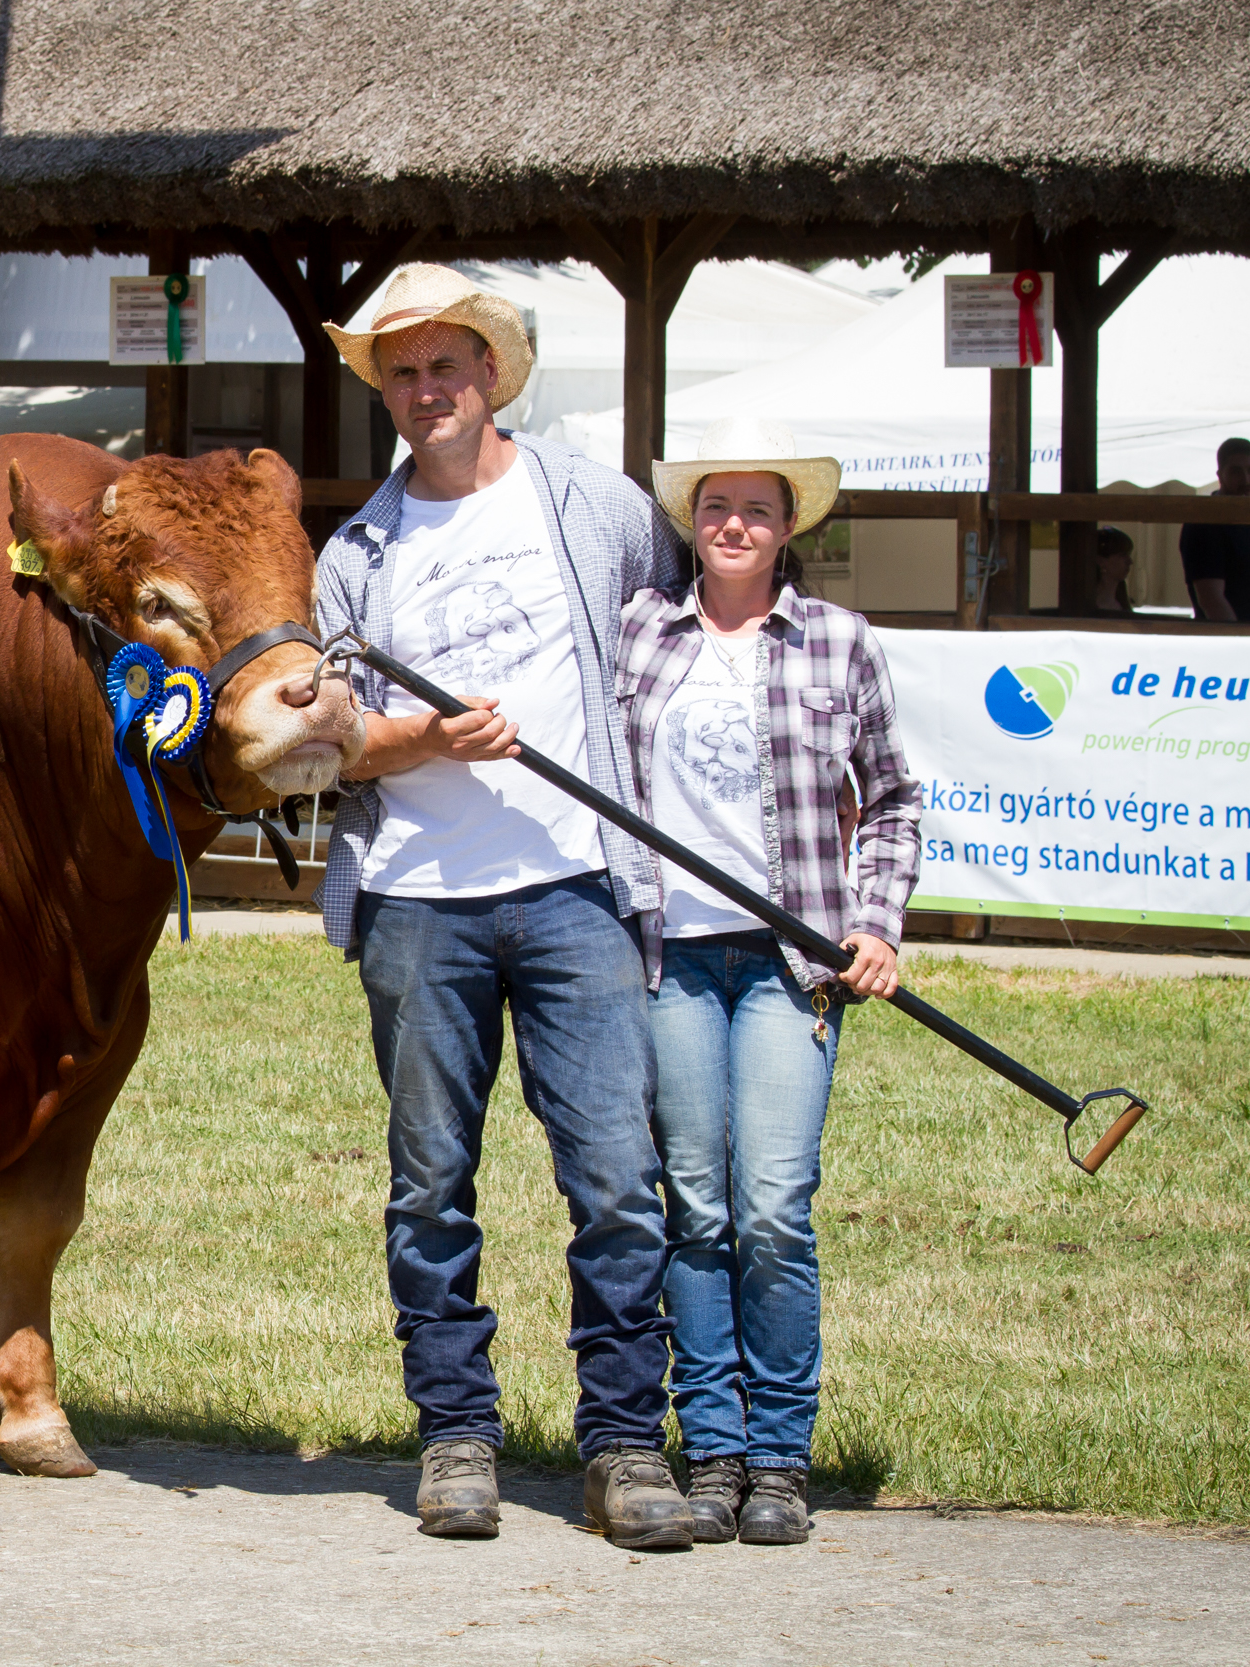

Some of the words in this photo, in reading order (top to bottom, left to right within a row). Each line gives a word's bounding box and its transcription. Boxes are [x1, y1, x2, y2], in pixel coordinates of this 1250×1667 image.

[841, 455, 944, 473] GYARTARKA
[883, 477, 990, 492] EGYESÜLET
[1111, 663, 1160, 696] de
[1172, 666, 1250, 701] heu
[1081, 732, 1190, 758] powering
[1196, 740, 1250, 763] prog
[1000, 787, 1095, 825] gyártó
[1105, 792, 1188, 832] végre
[1199, 807, 1215, 827] a
[1226, 808, 1250, 828] m
[963, 842, 1028, 876] meg
[1039, 843, 1211, 880] standunkat
[1219, 858, 1235, 881] a
